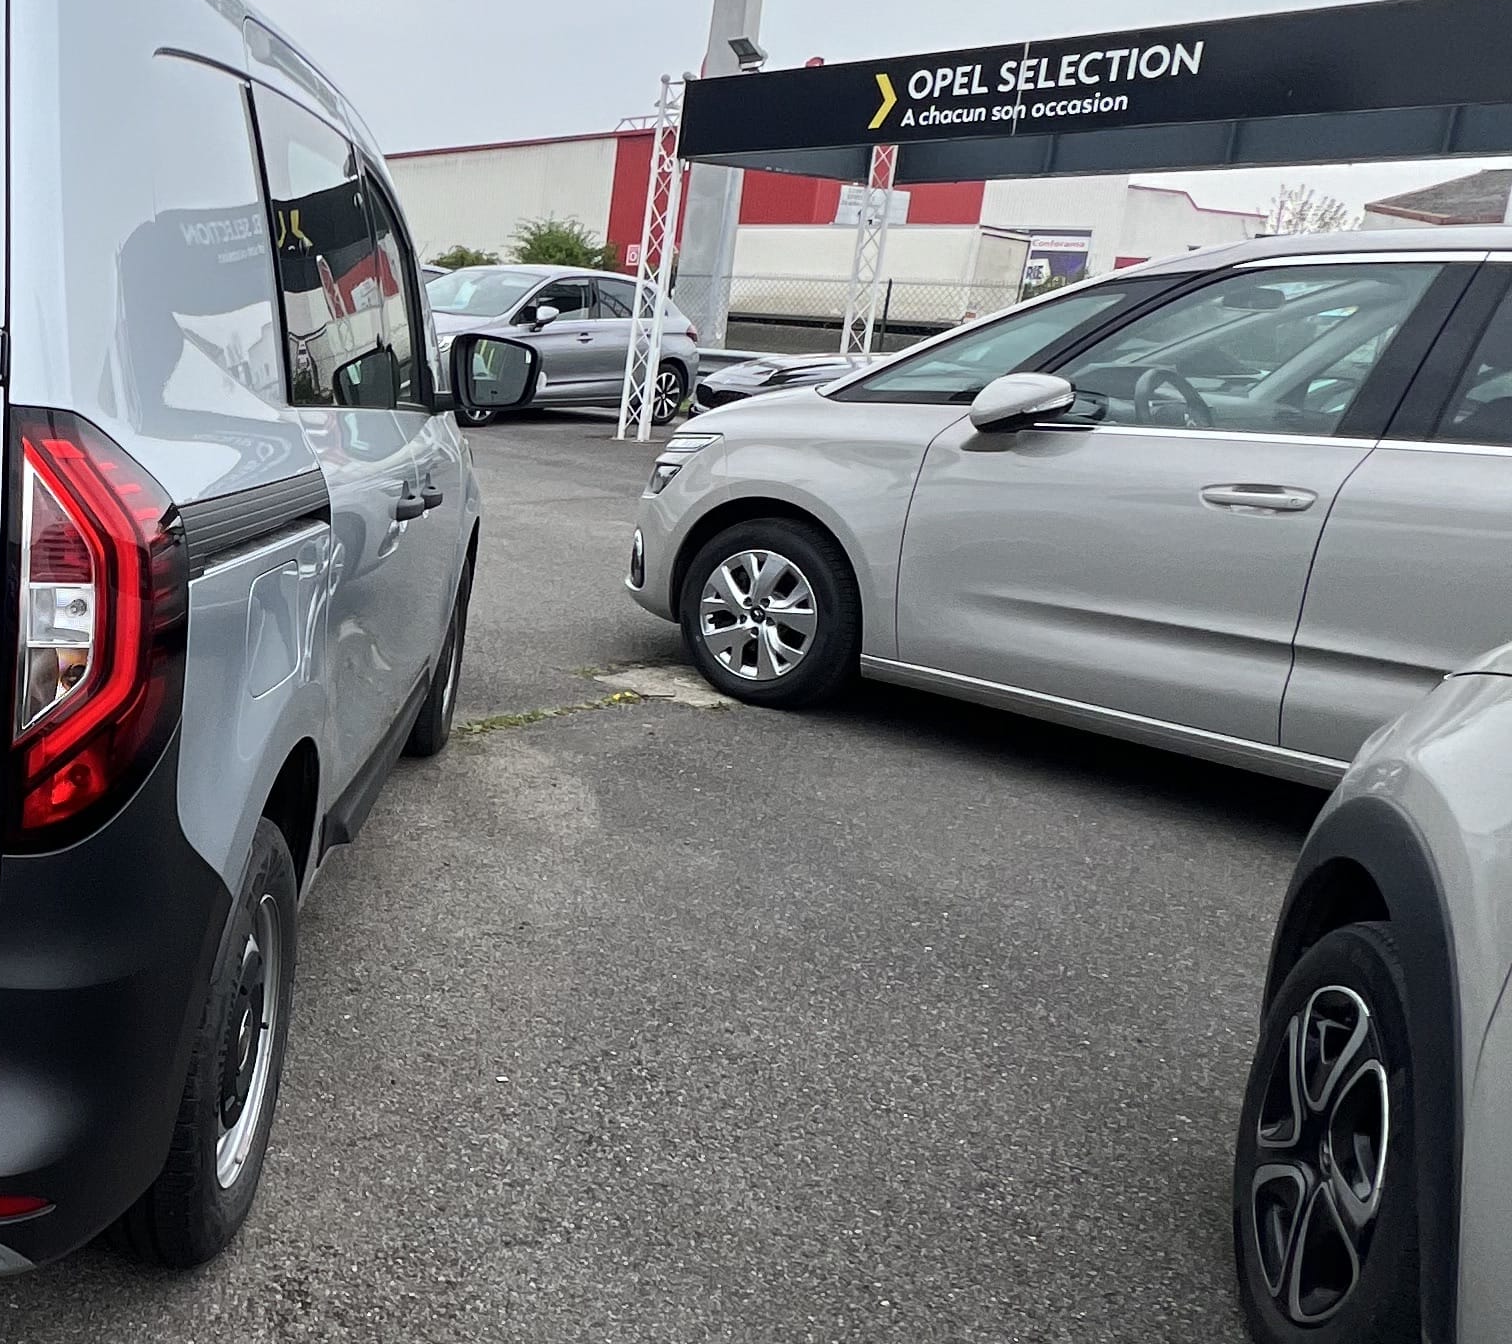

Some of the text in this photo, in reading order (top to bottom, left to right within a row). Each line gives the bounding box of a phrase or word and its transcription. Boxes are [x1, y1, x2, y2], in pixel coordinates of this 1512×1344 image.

[907, 40, 1205, 100] OPEL SELECTION
[900, 91, 1129, 128] A chacun son occasion
[1032, 239, 1085, 248] Conforama
